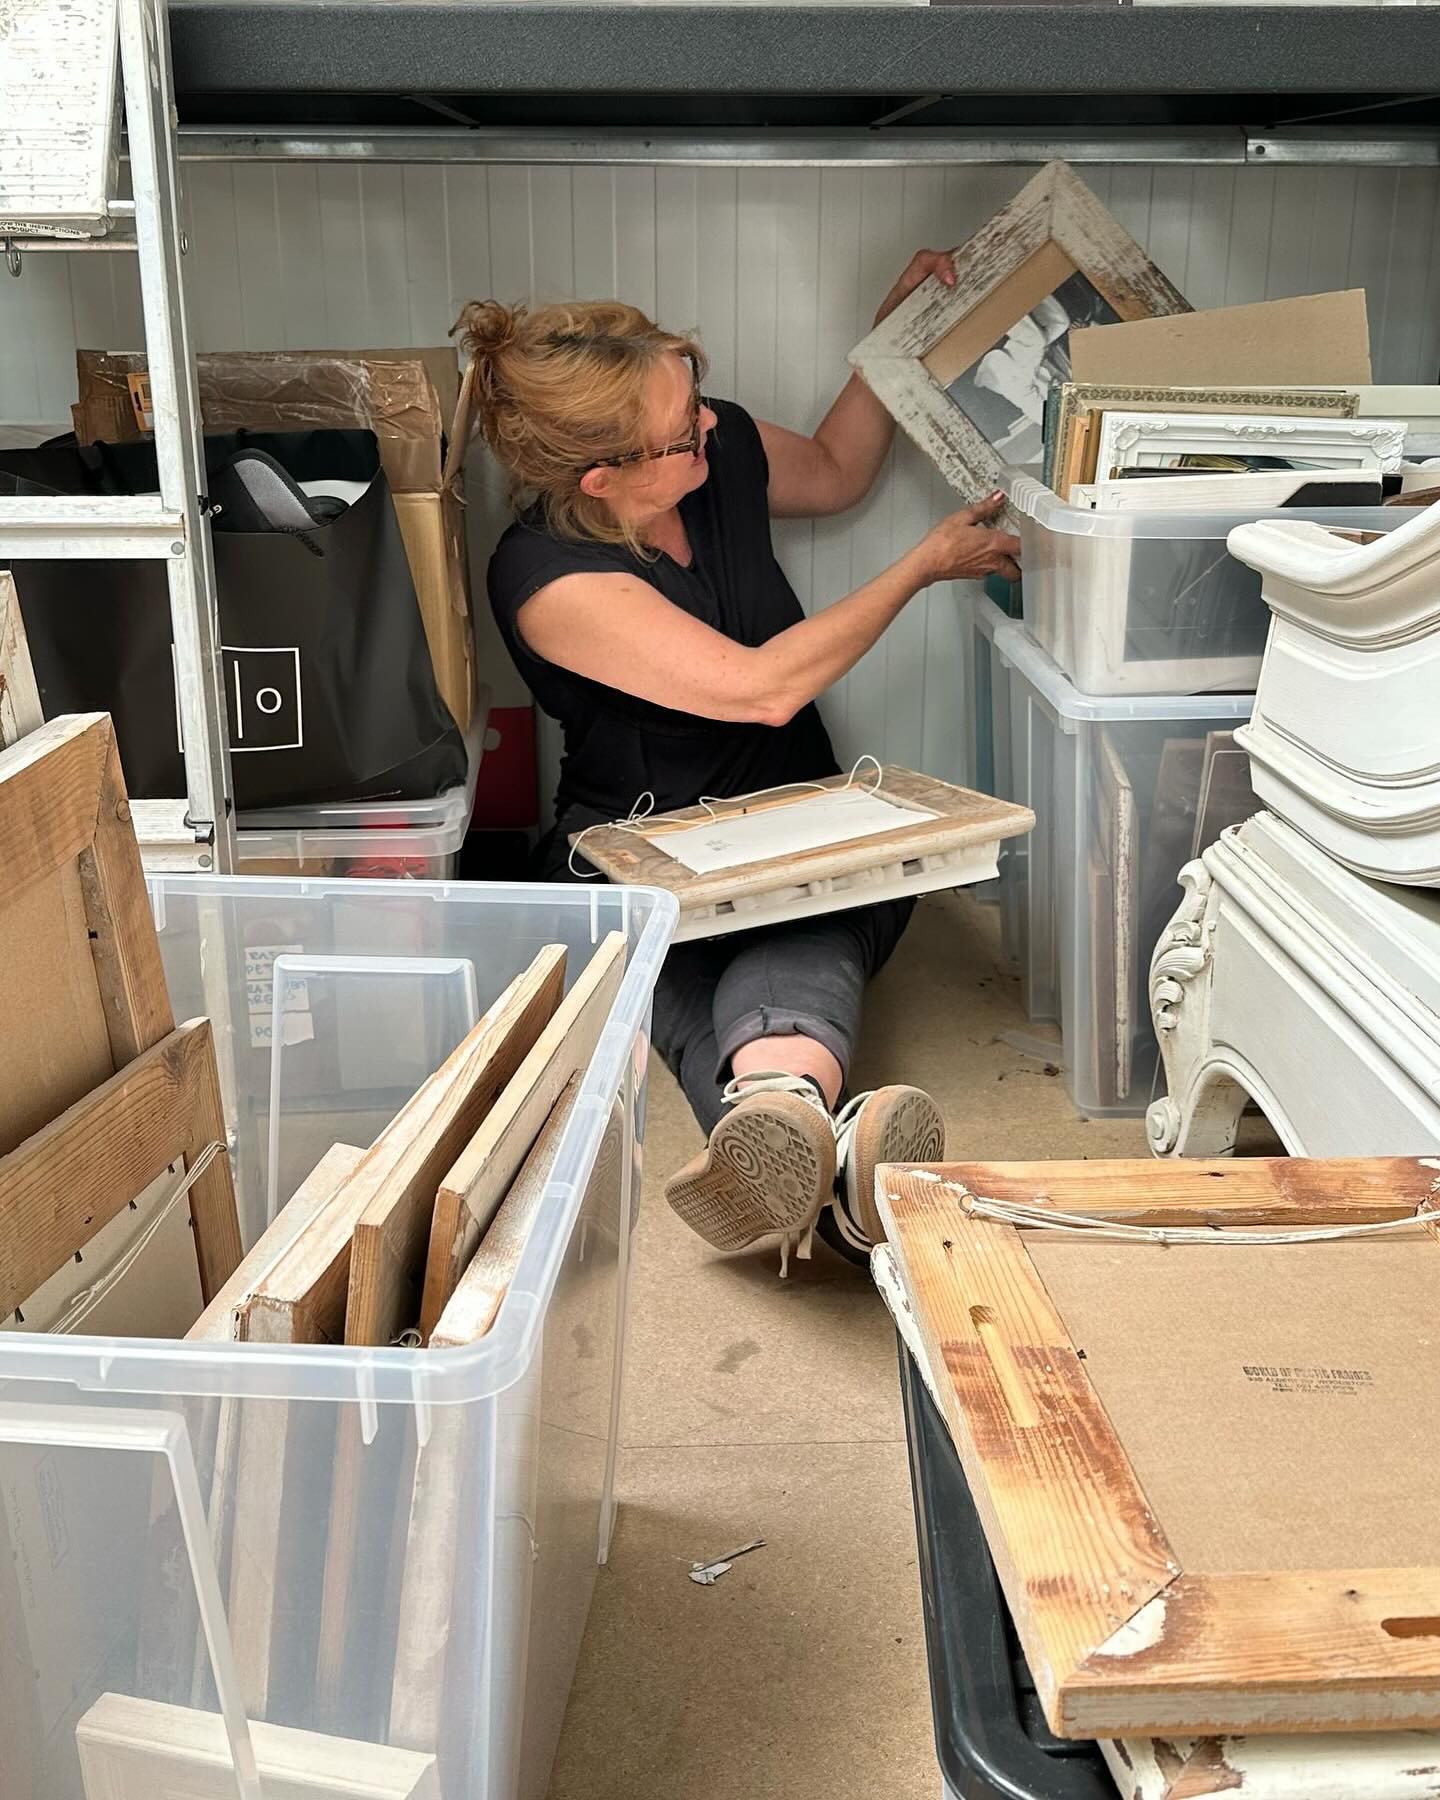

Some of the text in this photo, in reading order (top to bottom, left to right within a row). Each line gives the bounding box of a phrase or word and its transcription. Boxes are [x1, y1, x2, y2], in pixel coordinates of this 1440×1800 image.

[29, 223, 81, 235] INSTRUCTIONS
[1243, 1366, 1372, 1380] WORLD OF RTIC FRAMES
